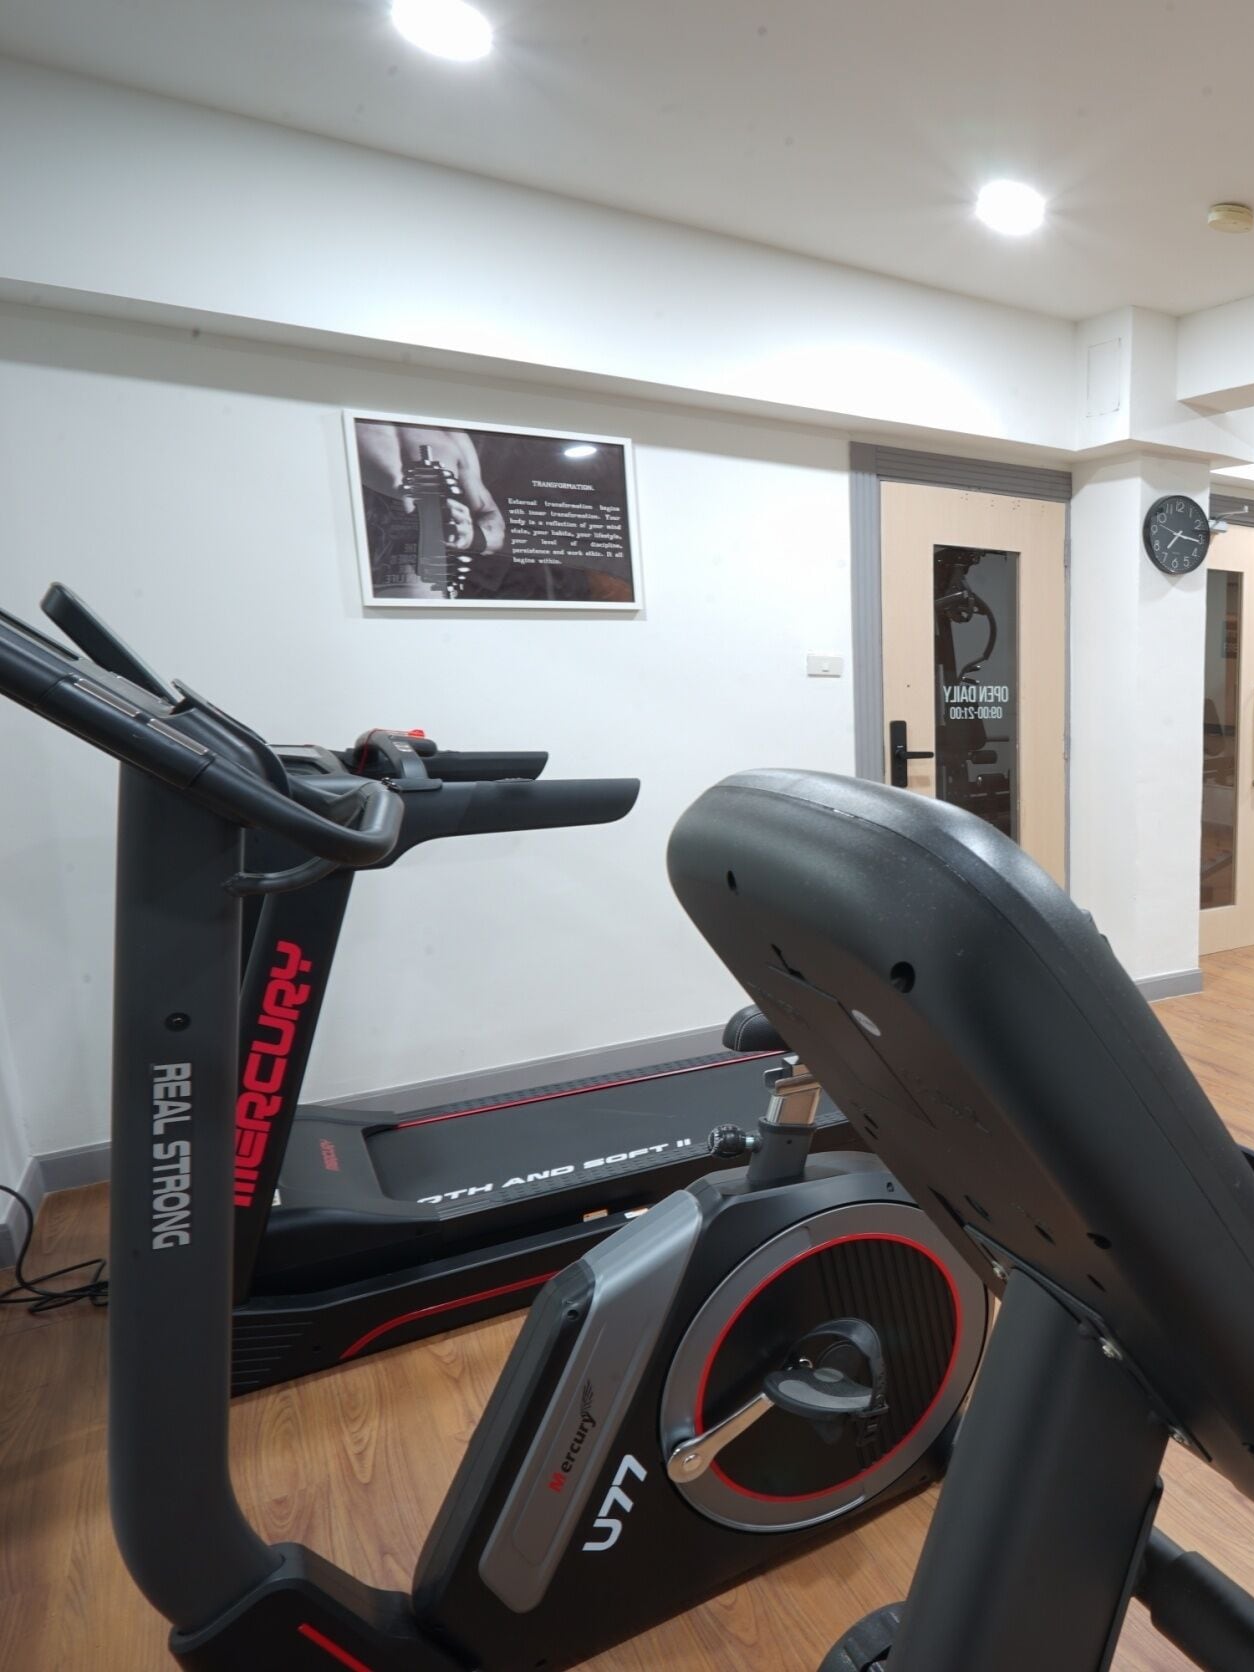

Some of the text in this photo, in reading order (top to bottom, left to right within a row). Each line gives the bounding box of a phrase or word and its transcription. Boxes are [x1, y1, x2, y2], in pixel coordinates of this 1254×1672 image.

[1176, 499, 1185, 512] 12
[152, 1062, 191, 1250] REAL STRONG
[502, 1165, 574, 1188] AND
[583, 1143, 669, 1170] SOFT
[547, 1412, 596, 1493] Mercury
[582, 1454, 647, 1551] U77
